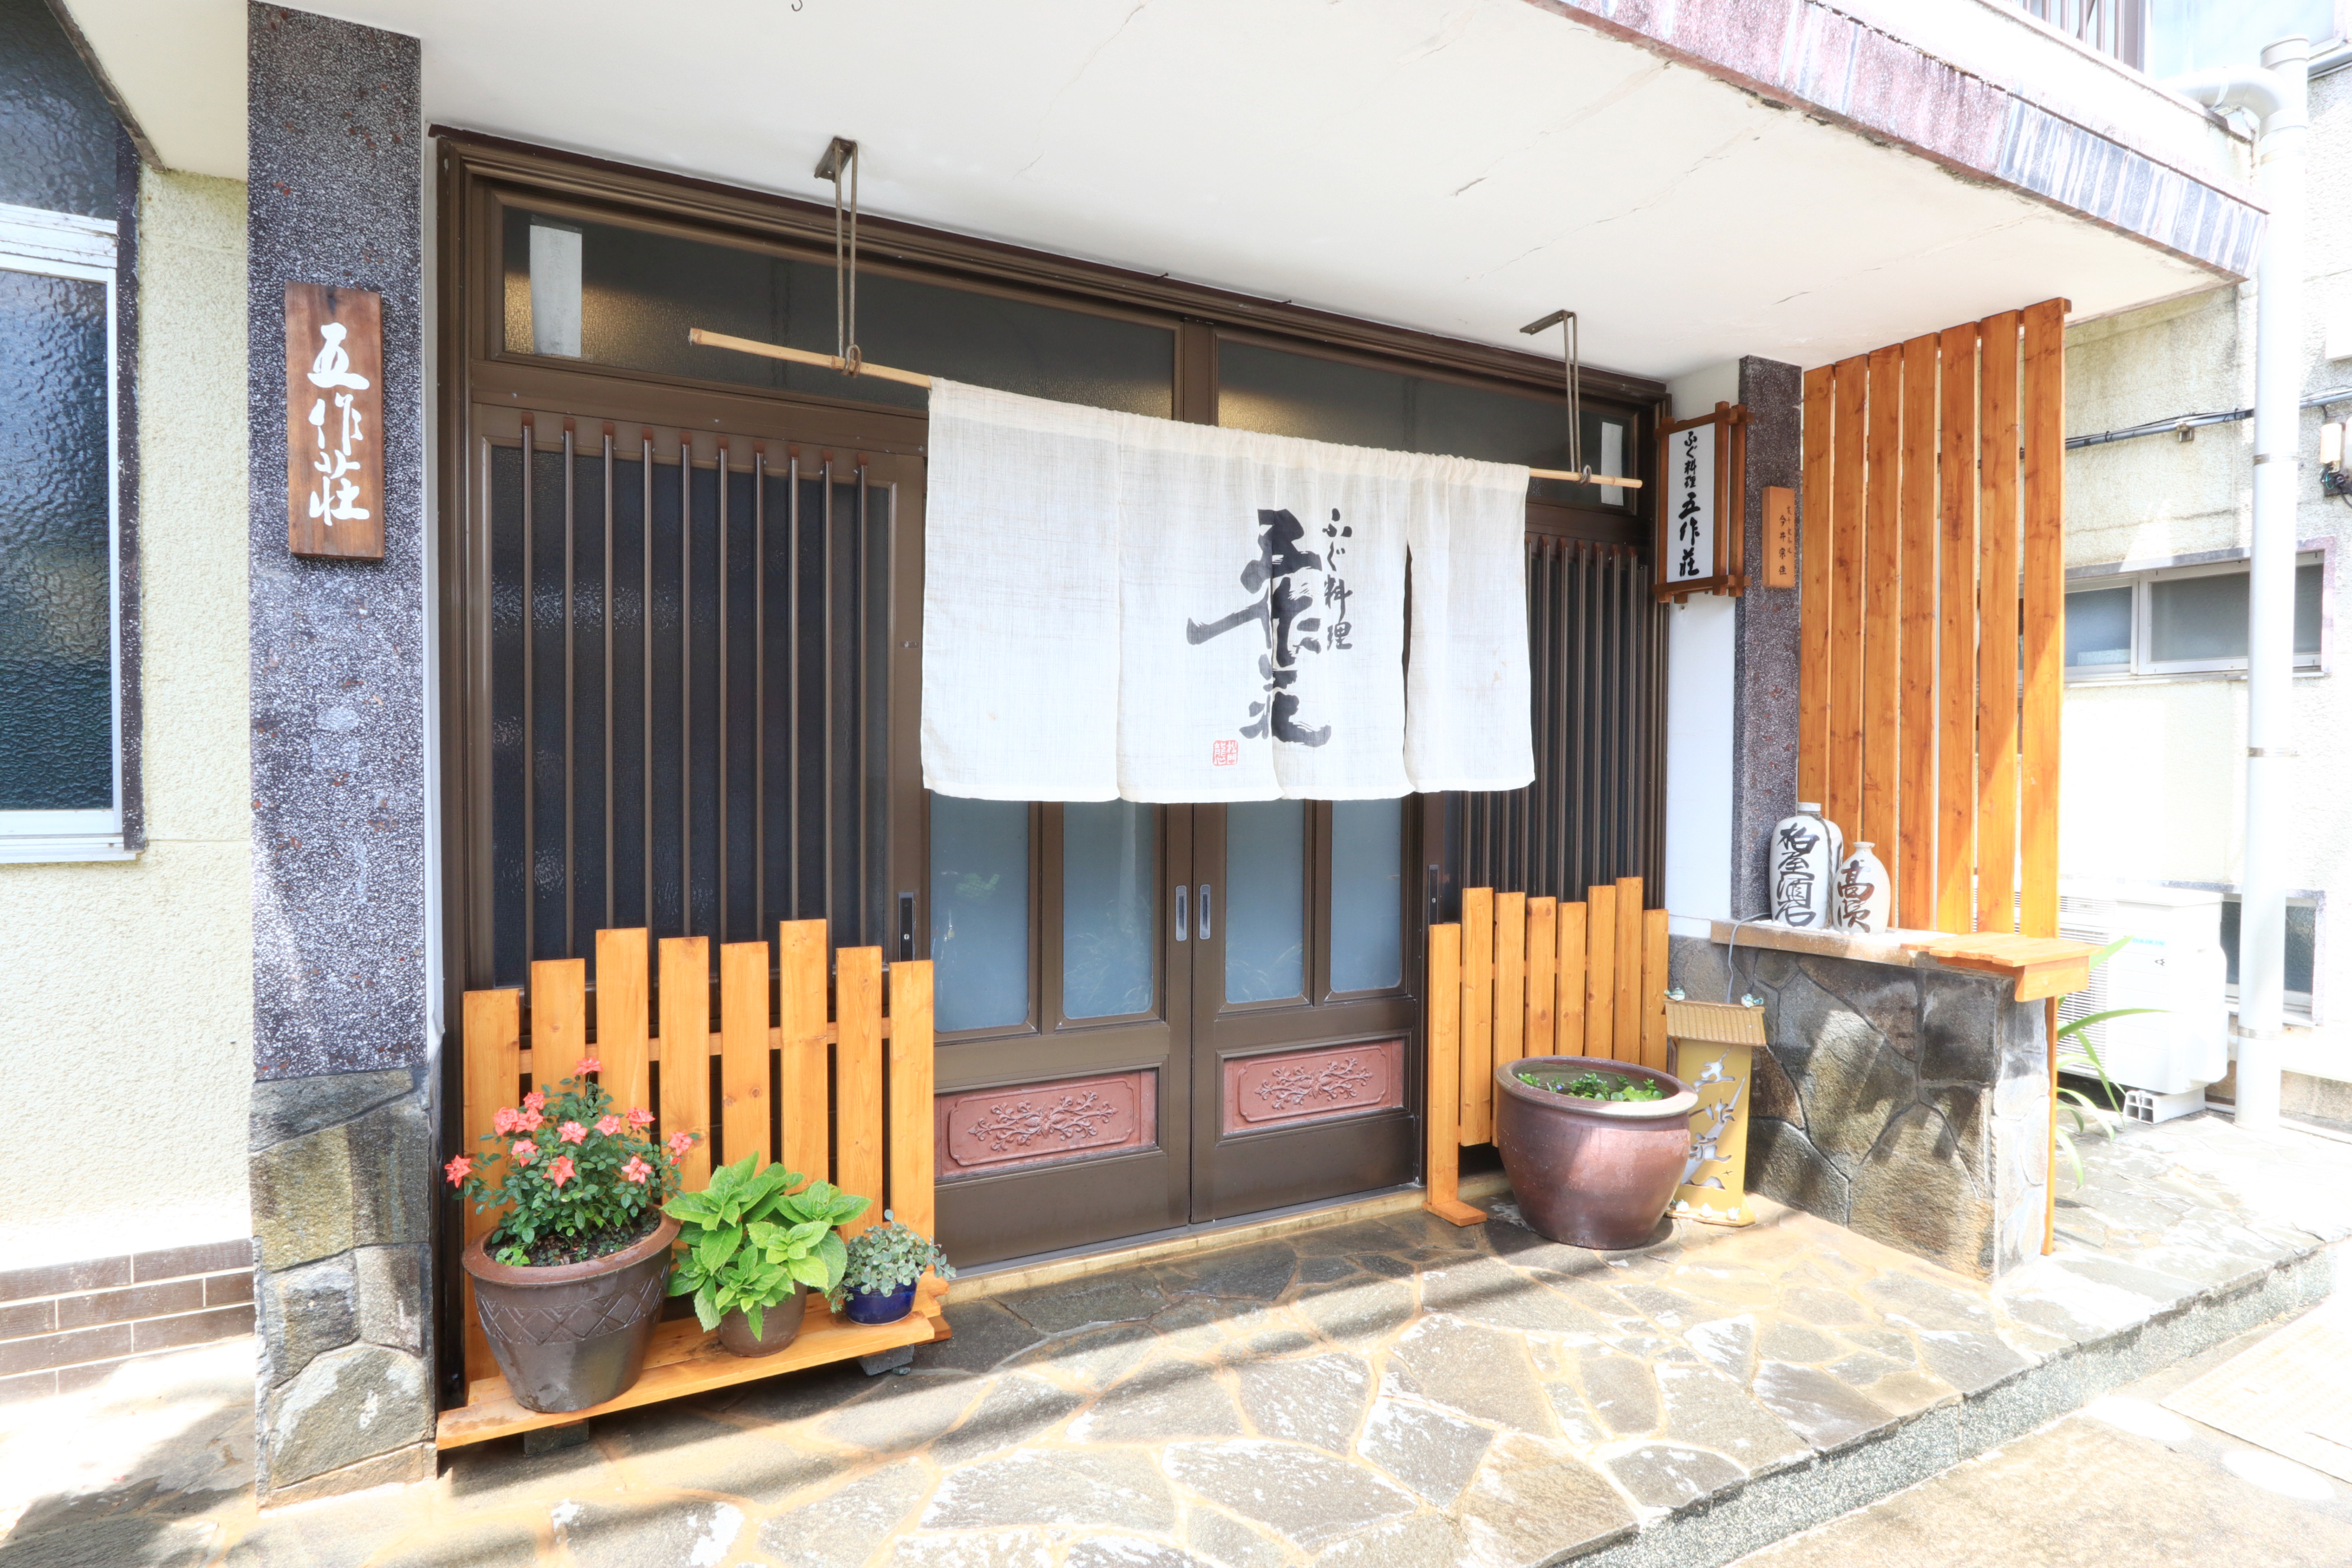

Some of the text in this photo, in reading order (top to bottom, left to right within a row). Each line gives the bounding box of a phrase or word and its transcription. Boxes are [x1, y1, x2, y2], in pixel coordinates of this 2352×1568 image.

[307, 322, 370, 527] 五作荘
[1678, 430, 1701, 577] ふぐ料理 五作荘
[1322, 508, 1353, 651] ふぐ料理
[2132, 937, 2165, 946] DAIKIN
